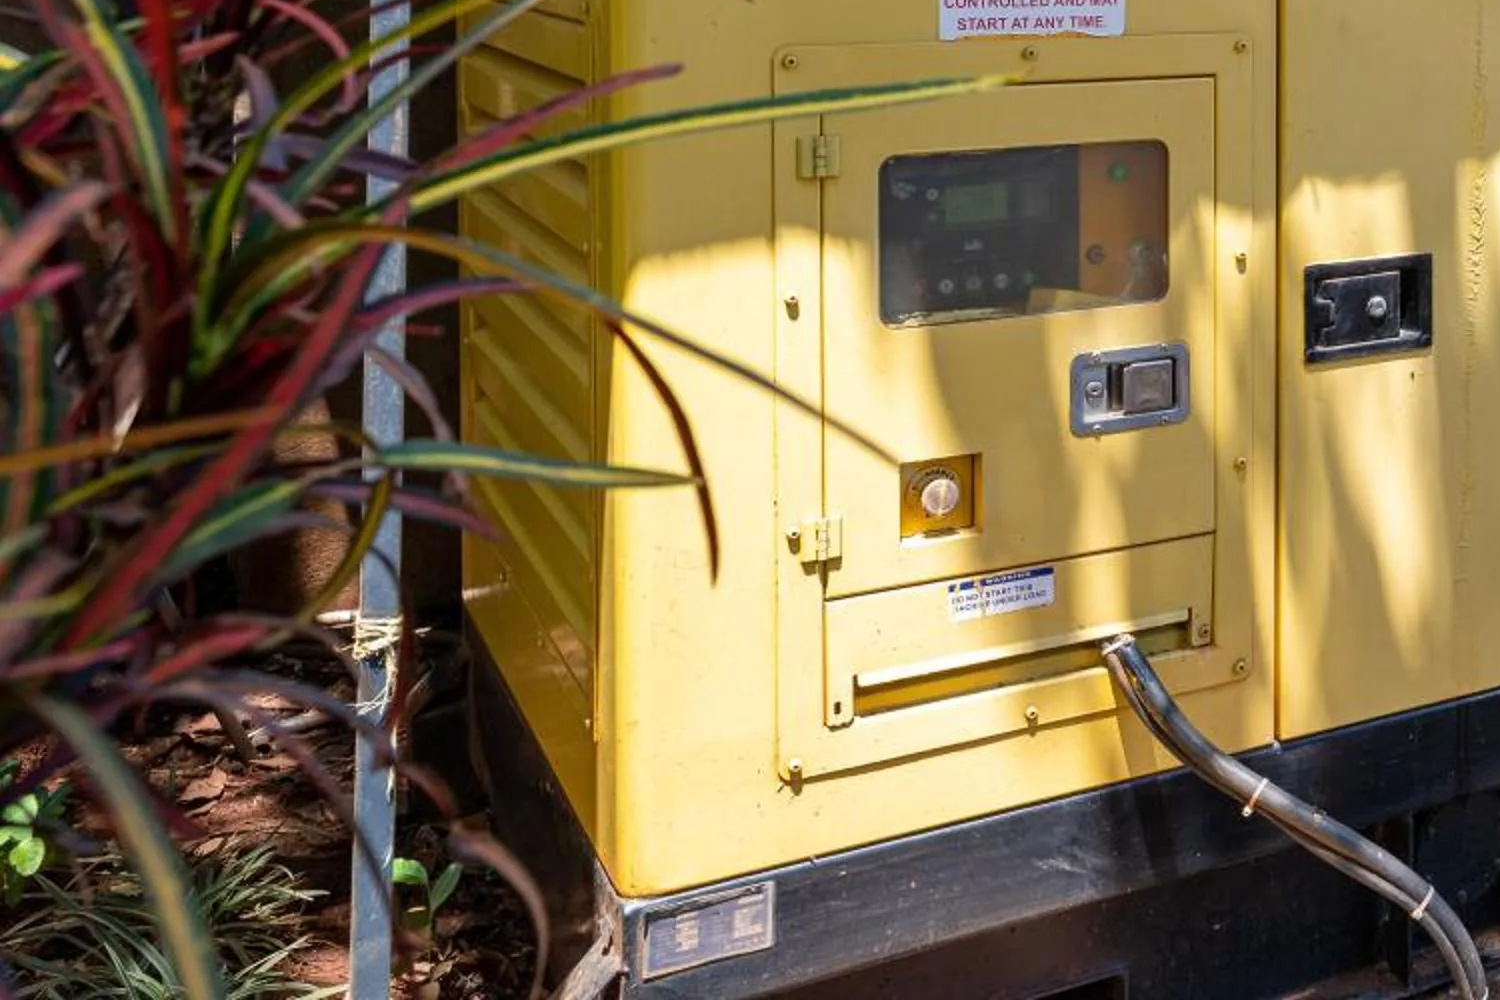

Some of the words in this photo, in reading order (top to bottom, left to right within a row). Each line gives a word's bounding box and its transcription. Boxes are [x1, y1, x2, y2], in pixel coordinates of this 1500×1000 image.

[957, 17, 1008, 31] START
[1011, 16, 1030, 29] AT
[1033, 16, 1065, 29] ANY
